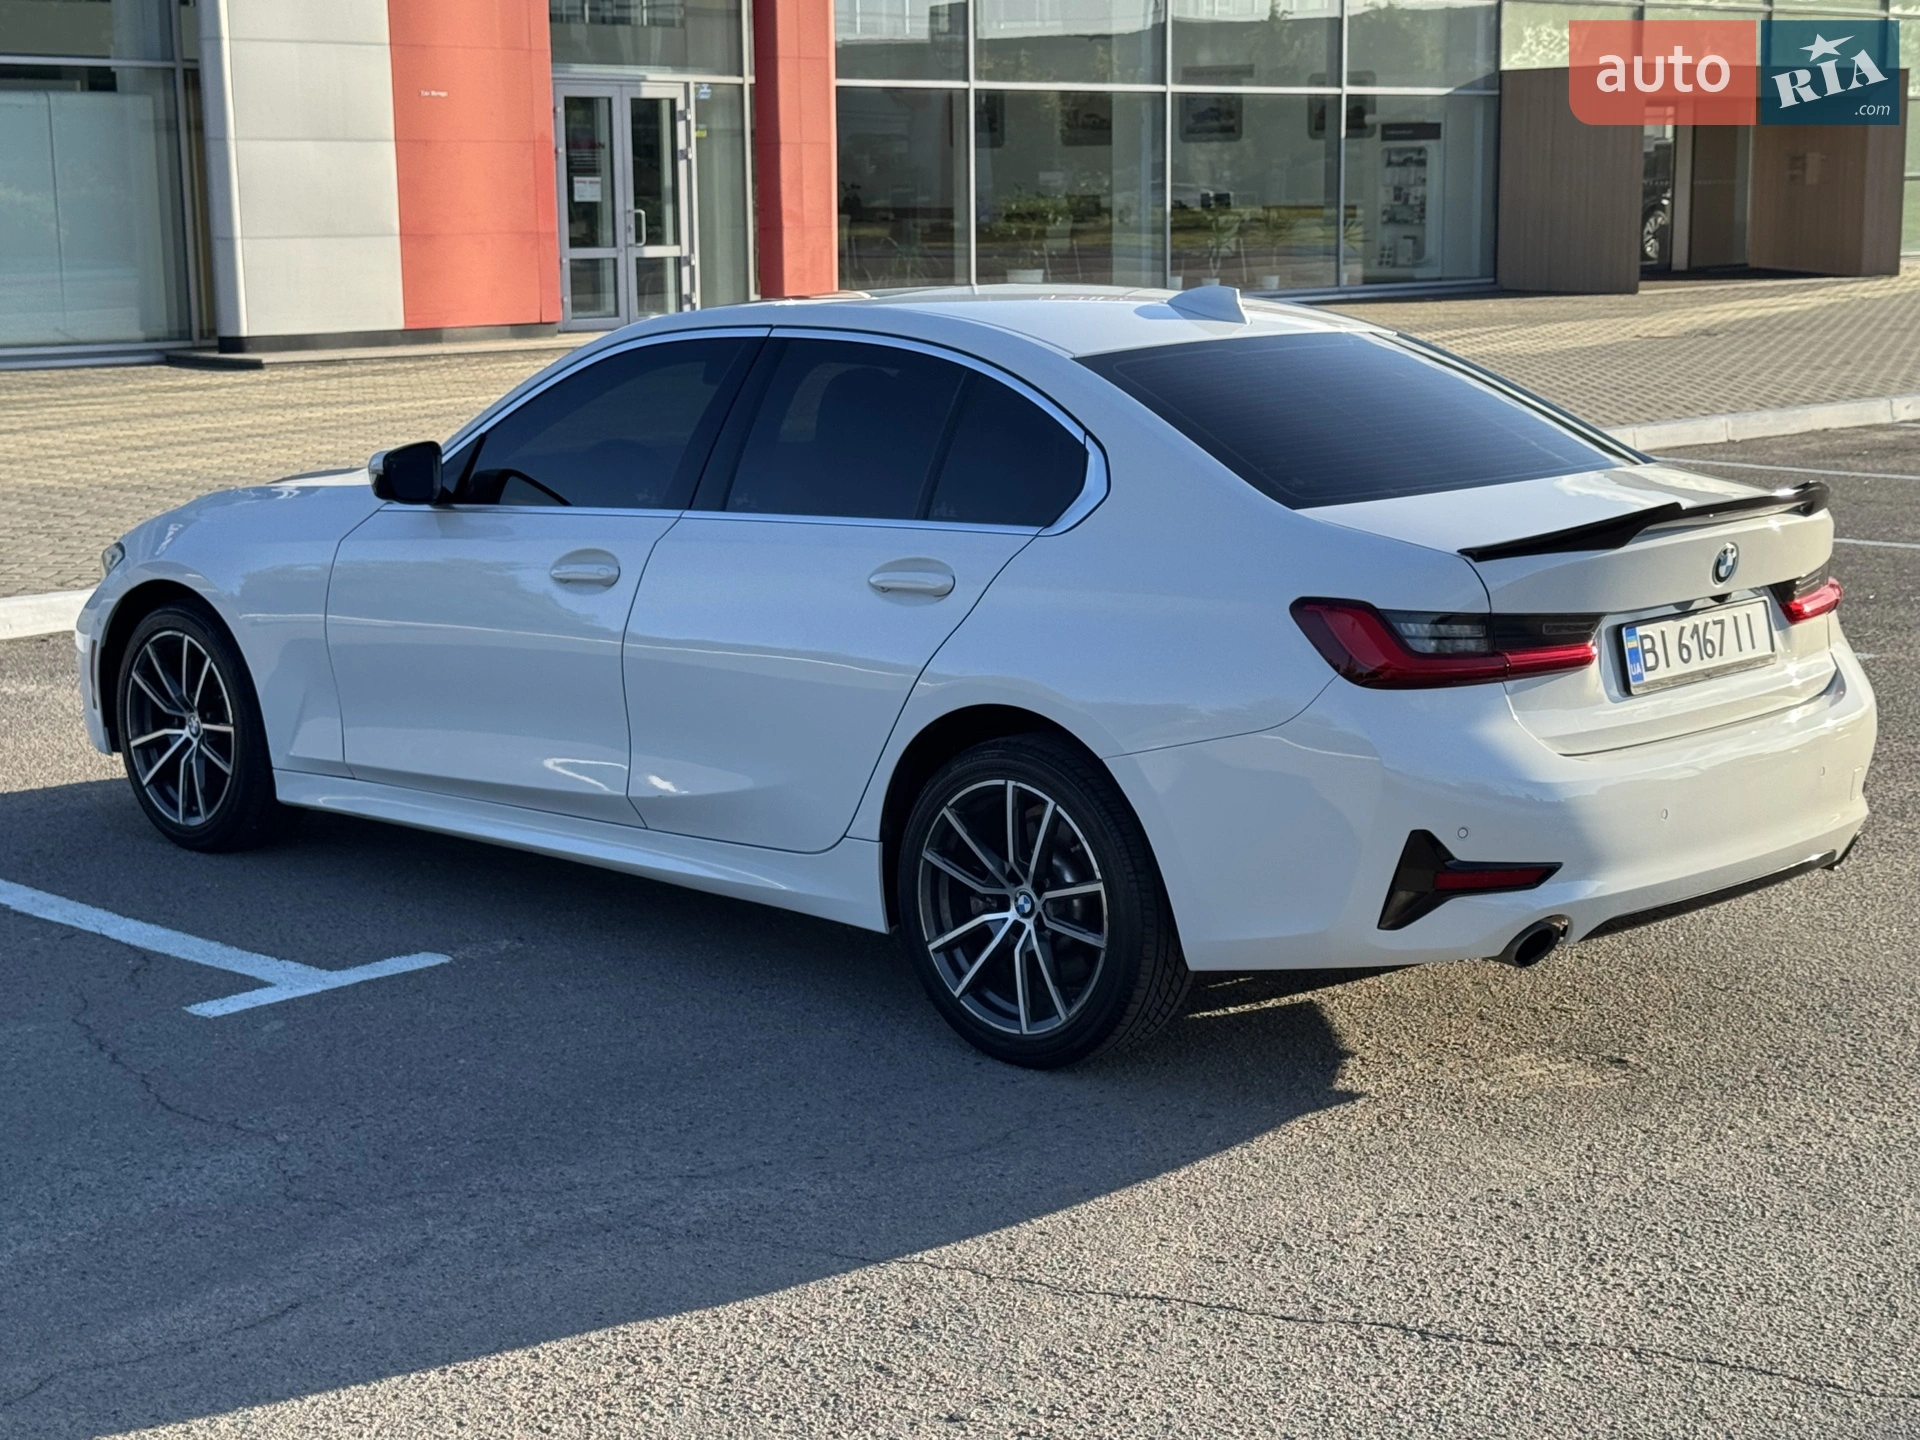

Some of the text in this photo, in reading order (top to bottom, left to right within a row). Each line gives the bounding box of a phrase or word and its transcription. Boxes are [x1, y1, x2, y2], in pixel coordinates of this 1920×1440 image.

[1639, 611, 1756, 672] BI 6167 II
[1630, 663, 1642, 676] UA
